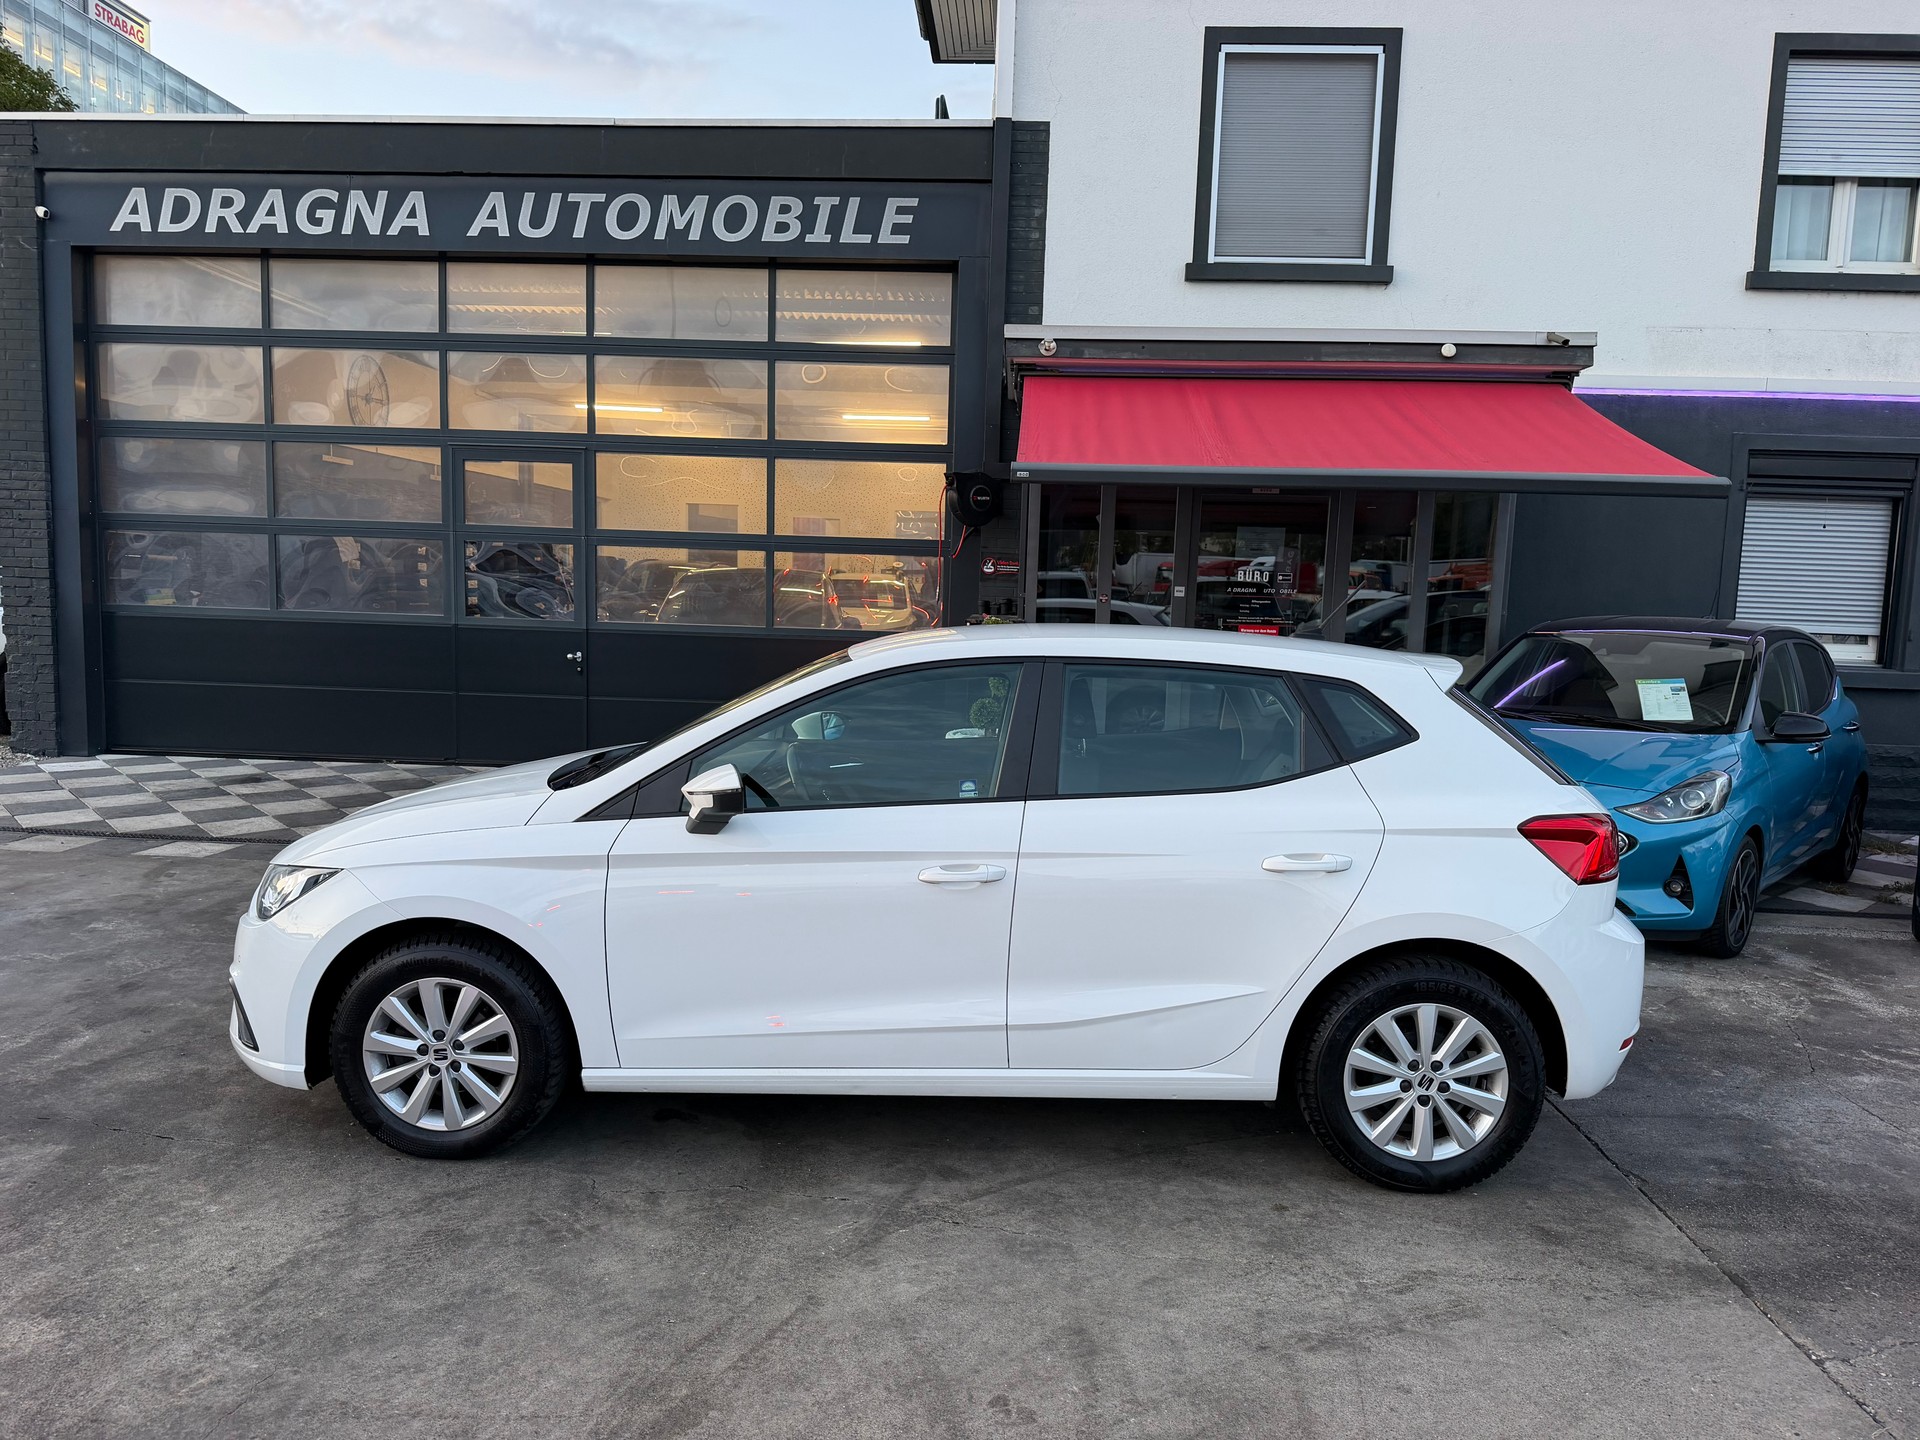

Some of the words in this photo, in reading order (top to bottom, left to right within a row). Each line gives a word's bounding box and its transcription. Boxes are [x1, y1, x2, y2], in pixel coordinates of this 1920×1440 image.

[94, 2, 145, 44] STRABAG
[109, 187, 430, 237] ADRAGNA
[466, 191, 920, 244] AUTOMOBILE
[1237, 569, 1269, 581] BÜRO
[1414, 981, 1457, 994] 185/65
